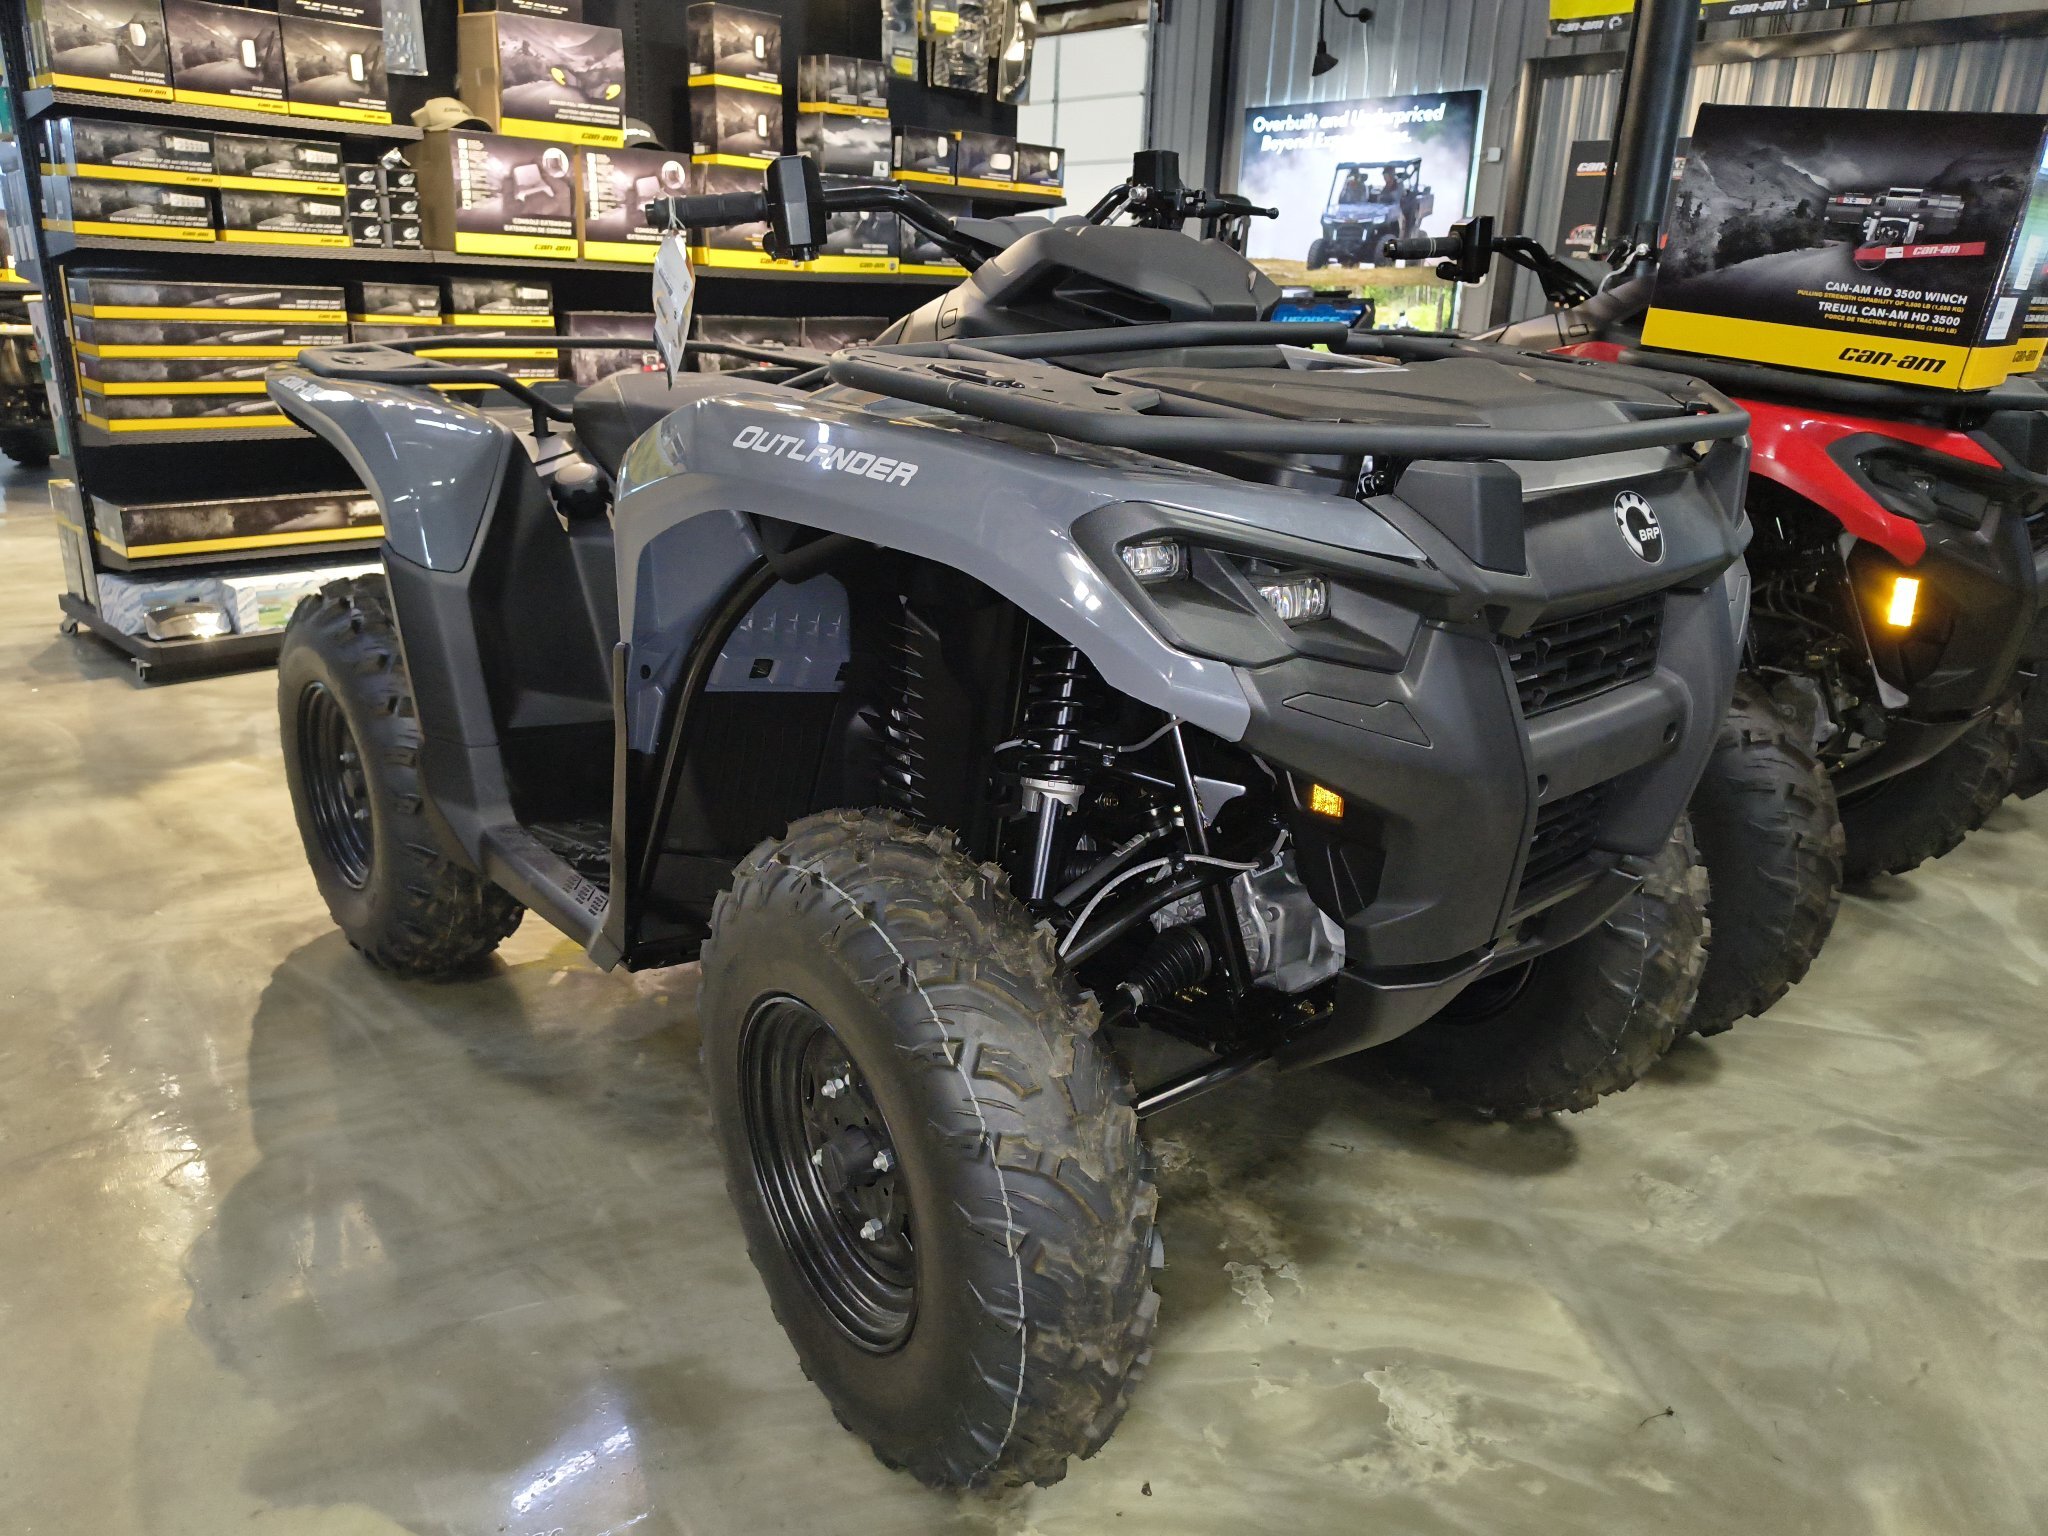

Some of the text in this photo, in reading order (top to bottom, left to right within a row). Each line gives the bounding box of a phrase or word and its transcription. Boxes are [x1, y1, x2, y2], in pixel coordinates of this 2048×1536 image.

[1729, 0, 1787, 15] can-am
[1557, 20, 1604, 32] can-am
[1253, 102, 1446, 133] Overbuilt and Underpriced
[1261, 133, 1314, 155] Beyond
[1913, 245, 1960, 255] can-am
[1797, 289, 1822, 298] PULLING
[1824, 292, 1856, 301] STRENGTH
[1857, 295, 1893, 305] CAPABILITY
[1825, 281, 1968, 305] CAN-AM HD 3500 WINCH
[1818, 301, 1960, 326] TREUIL CAN-AM HD 3500
[1824, 313, 1846, 321] FORCE
[1856, 316, 1887, 326] TRACTION
[1838, 347, 1946, 374] can-am
[2012, 350, 2039, 362] can-am
[732, 425, 918, 487] OUTLANDER
[1639, 527, 1659, 541] BRP
